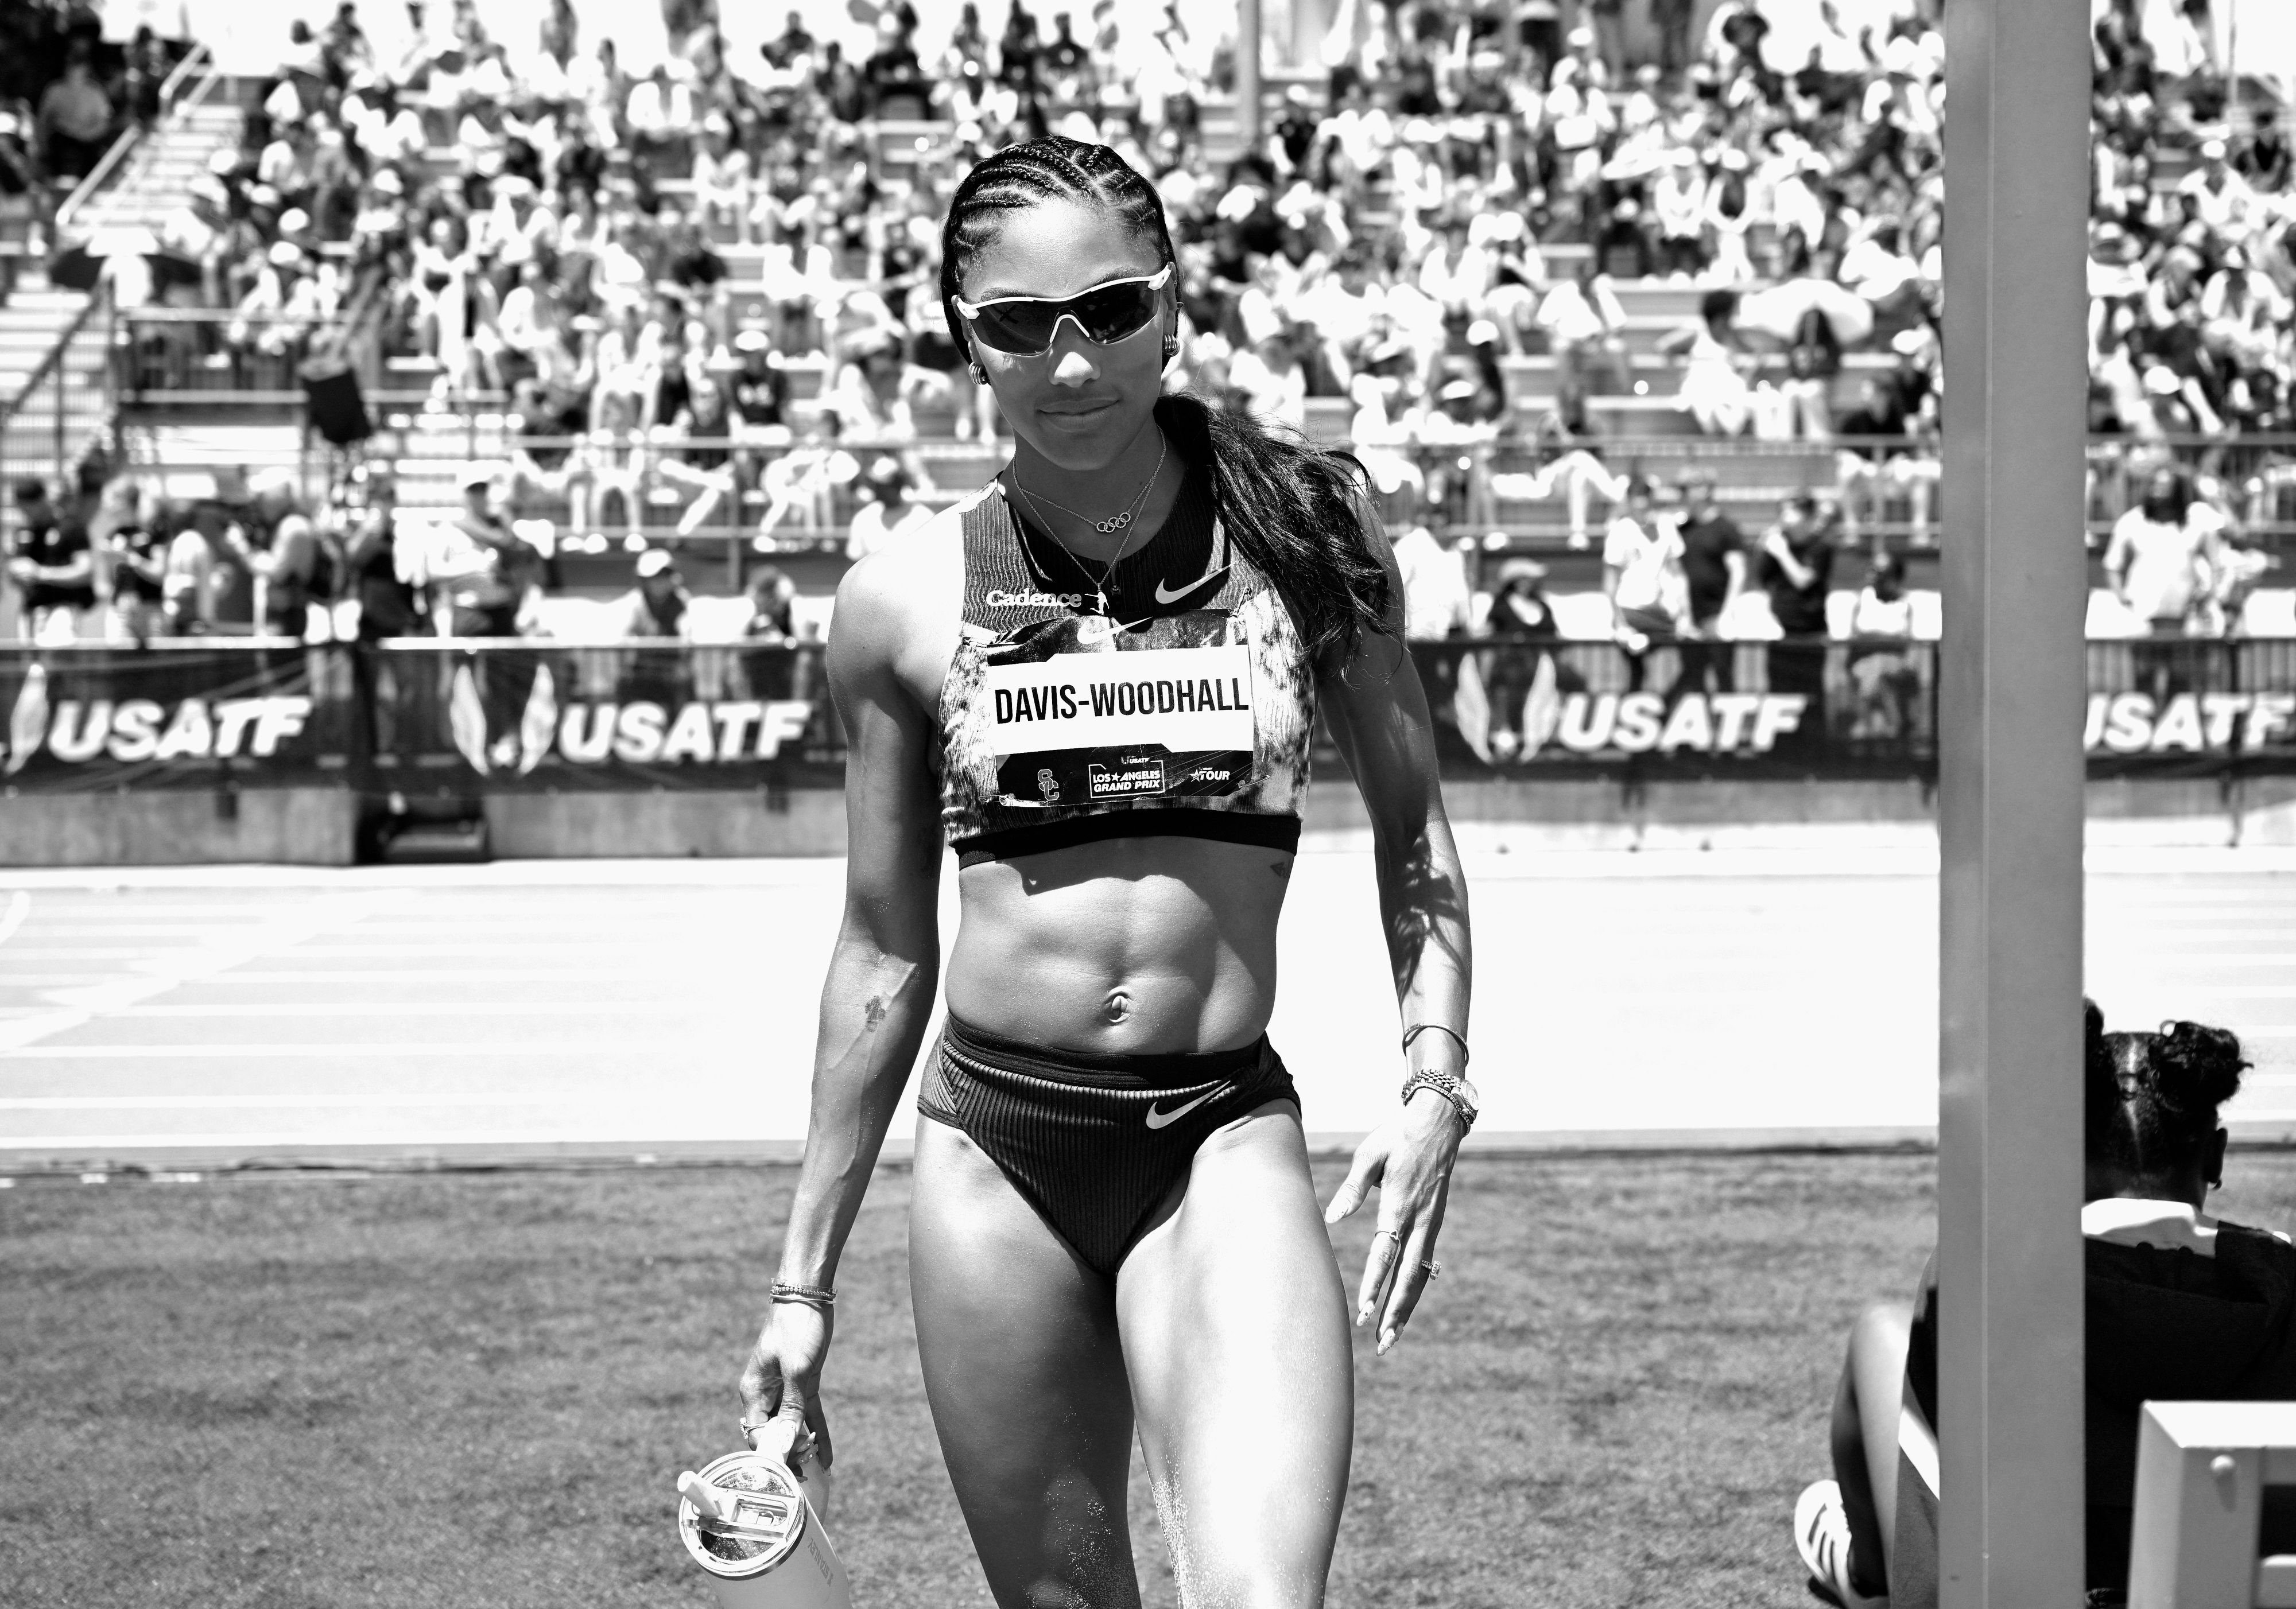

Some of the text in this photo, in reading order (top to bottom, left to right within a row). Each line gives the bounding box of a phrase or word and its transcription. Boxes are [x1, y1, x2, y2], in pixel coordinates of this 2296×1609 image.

[986, 588, 1082, 607] Cadence
[995, 678, 1249, 724] DAVIS-WOODHALL
[1558, 692, 1808, 751] USATF
[49, 698, 313, 762] USATF
[559, 700, 811, 762] USATF
[1093, 770, 1161, 783] LOS ANGELES
[1093, 779, 1161, 792] GRAND PRIX
[1199, 771, 1230, 780] TOUR
[808, 1538, 830, 1579] STANLEY
